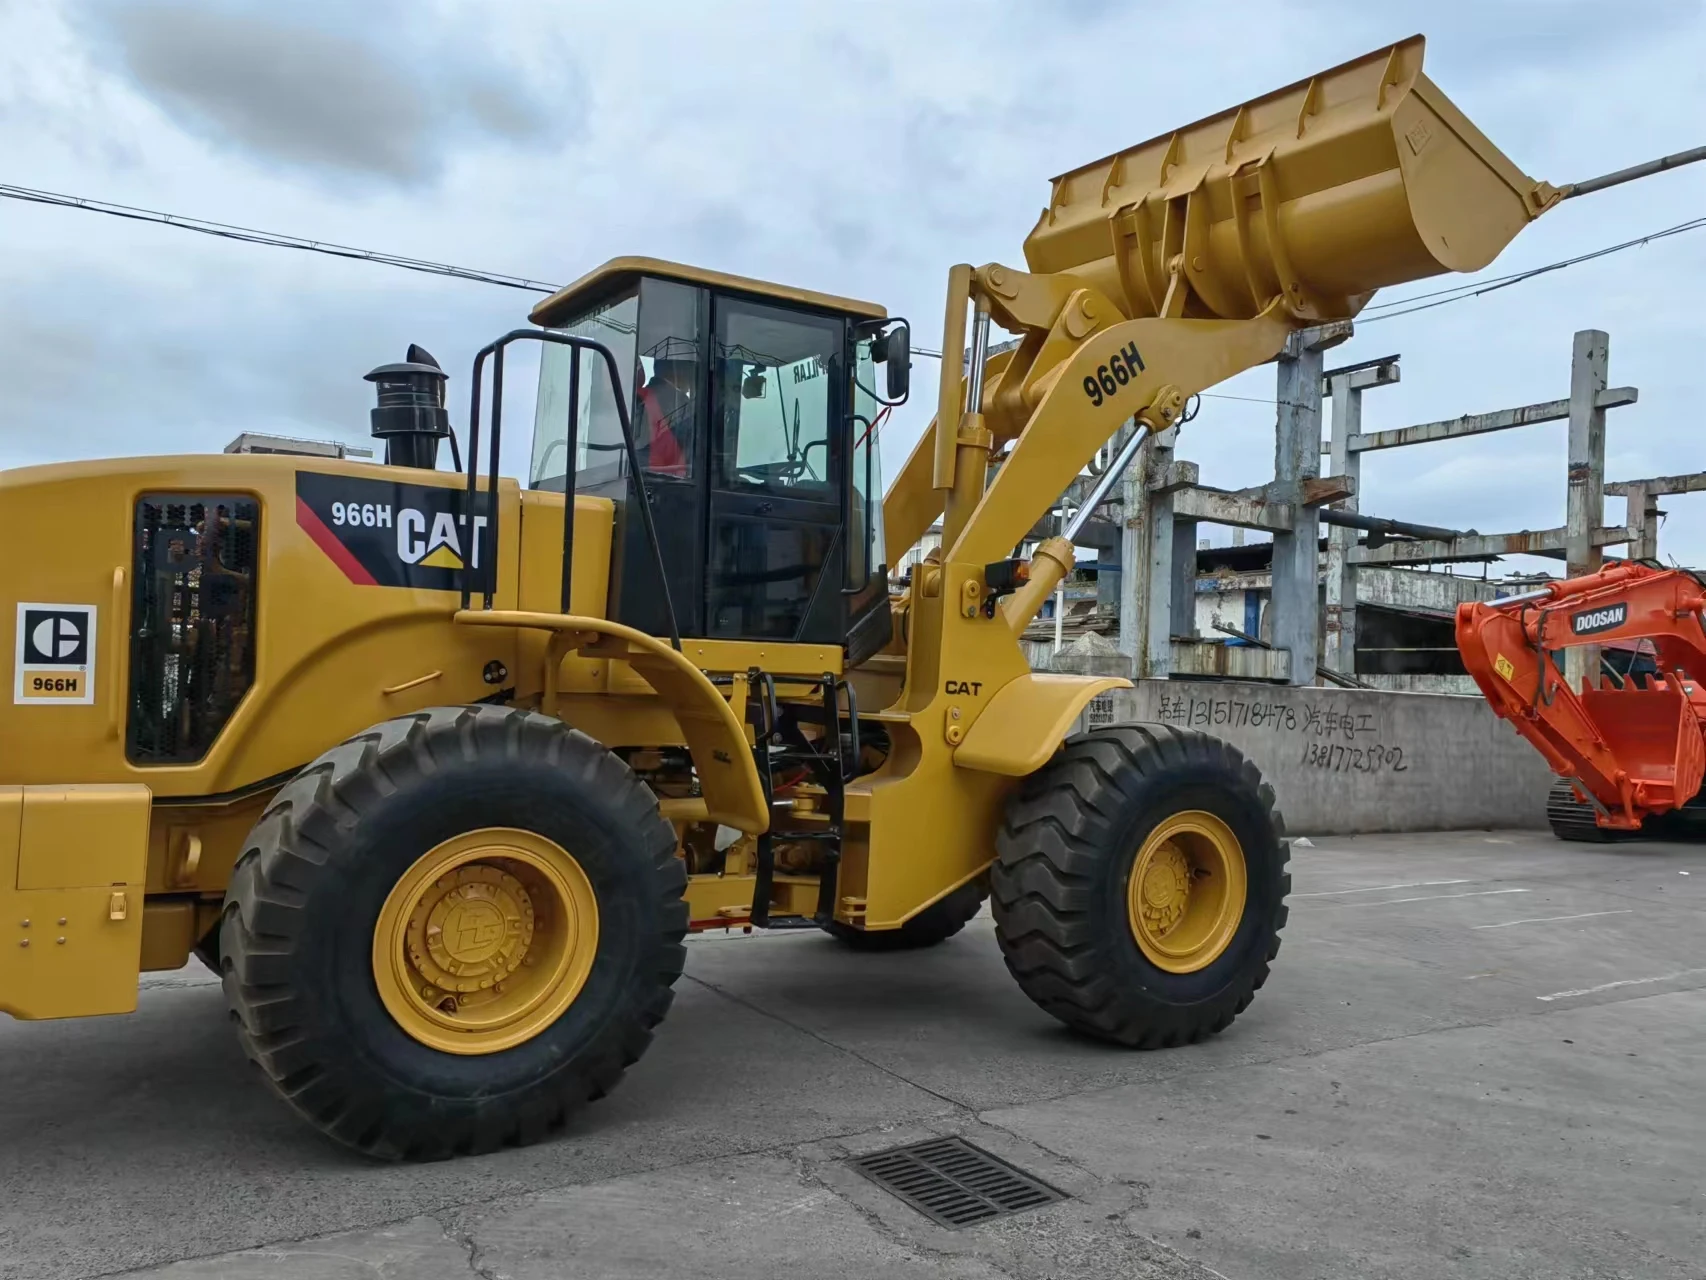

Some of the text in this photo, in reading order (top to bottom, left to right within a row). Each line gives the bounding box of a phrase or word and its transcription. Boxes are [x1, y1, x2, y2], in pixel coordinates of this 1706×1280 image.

[1083, 341, 1145, 407] 966H
[331, 502, 392, 528] 966H
[397, 508, 487, 569] CAT
[1576, 607, 1624, 632] DOOSAN
[33, 677, 77, 692] 966H
[945, 680, 983, 696] CAT
